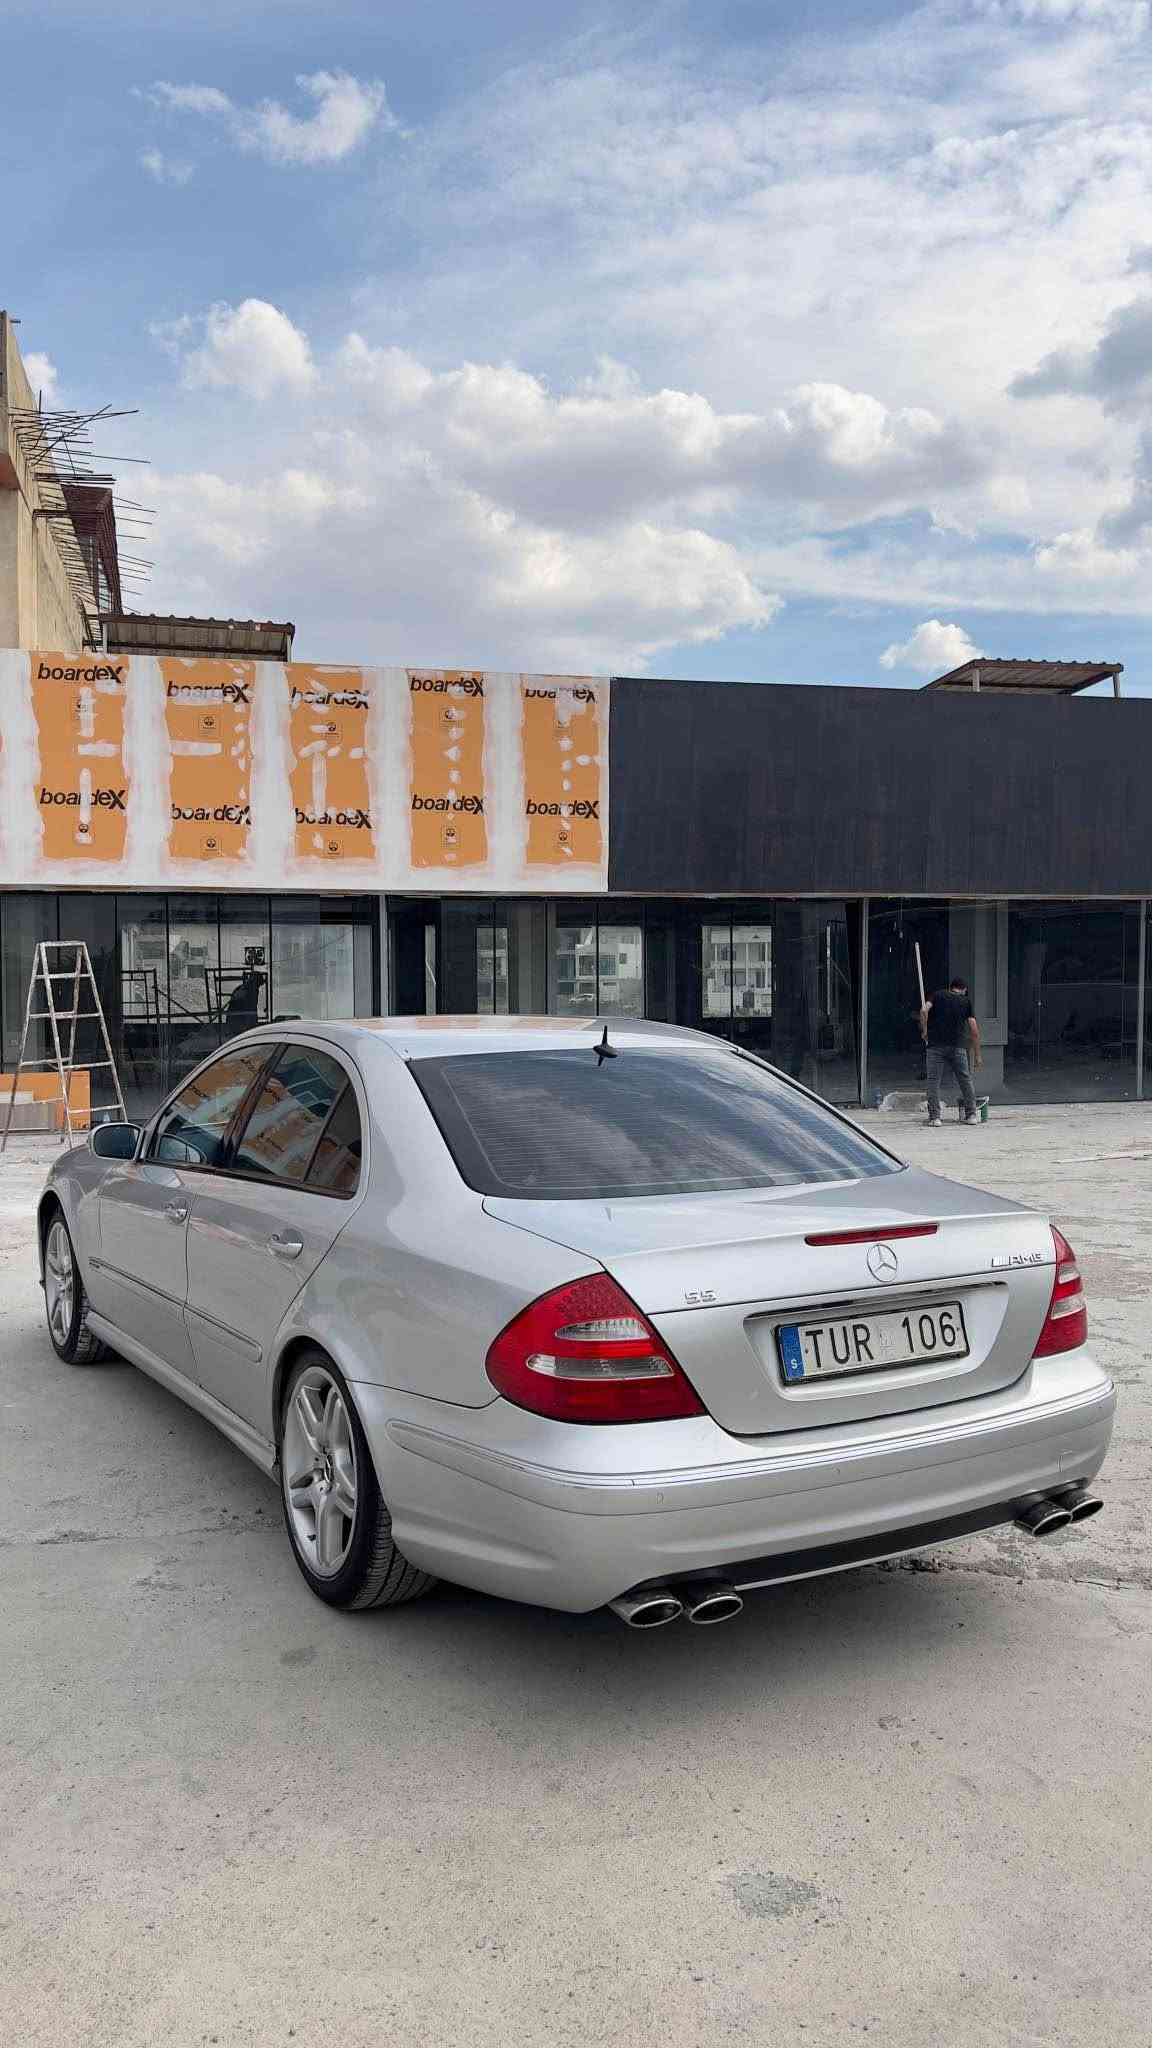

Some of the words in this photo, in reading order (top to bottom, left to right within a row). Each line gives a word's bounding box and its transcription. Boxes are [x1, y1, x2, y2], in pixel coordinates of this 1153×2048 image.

[805, 1323, 874, 1368] TUR
[902, 1311, 956, 1353] 106
[791, 1359, 798, 1369] S
